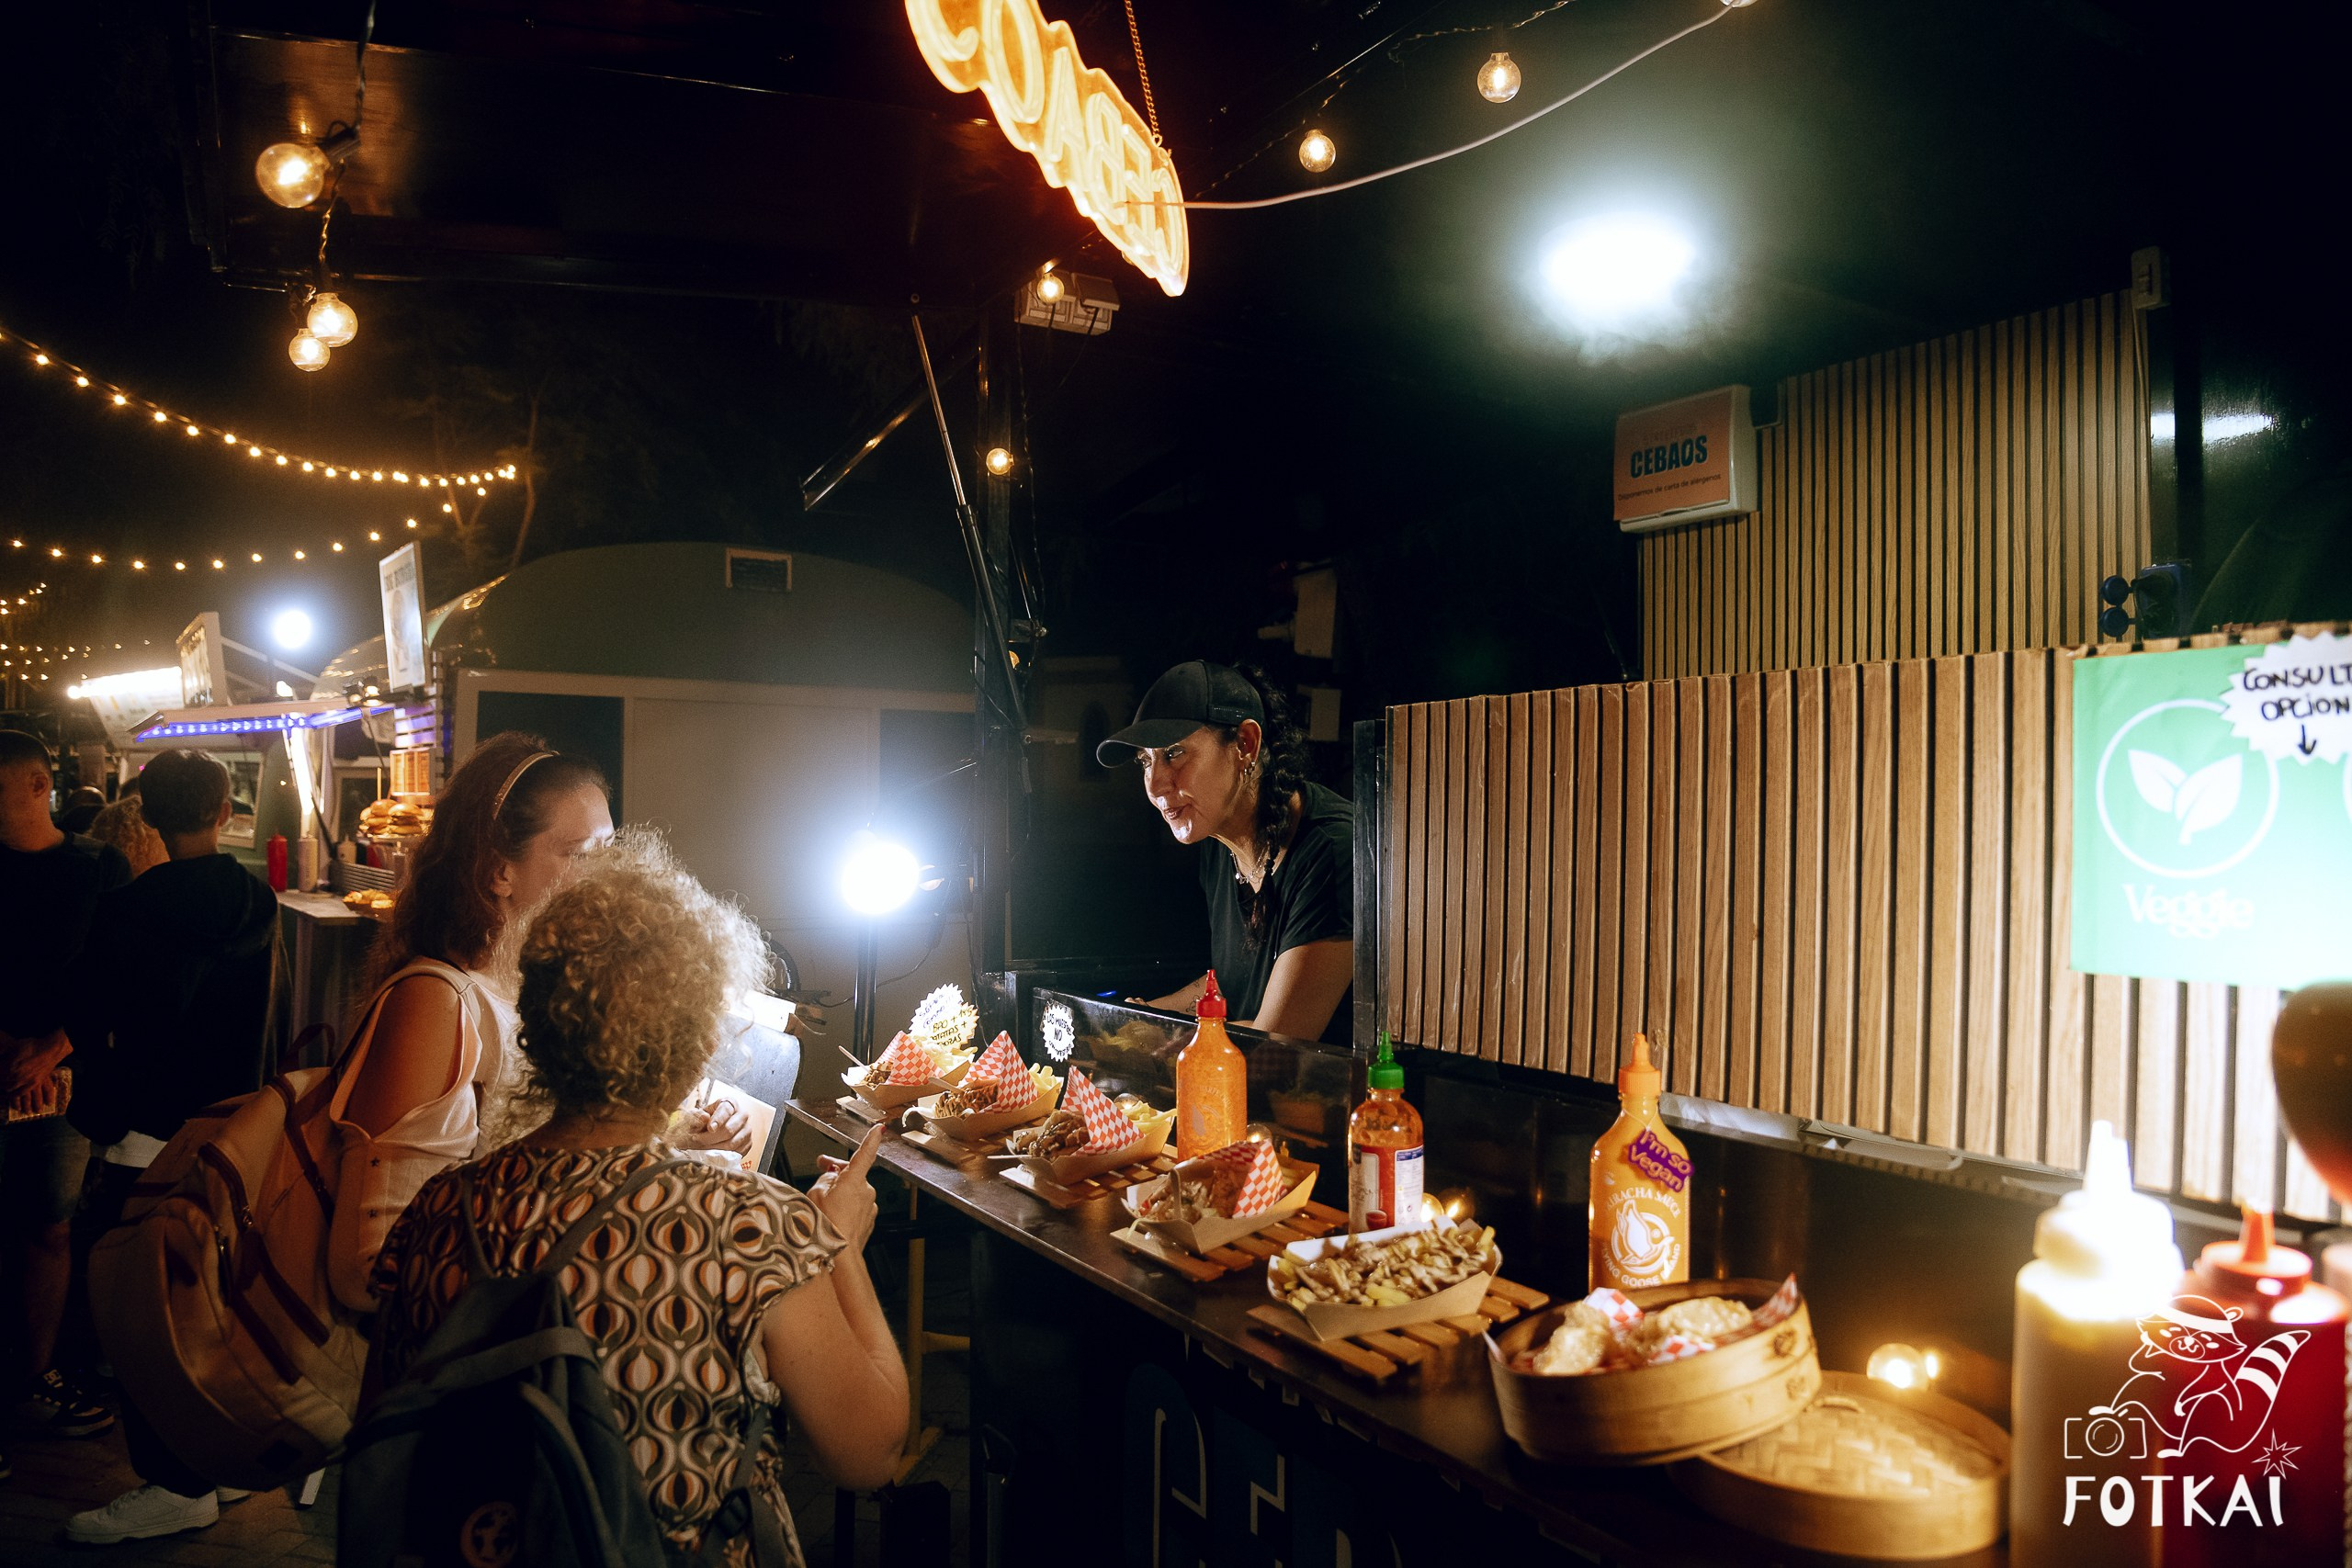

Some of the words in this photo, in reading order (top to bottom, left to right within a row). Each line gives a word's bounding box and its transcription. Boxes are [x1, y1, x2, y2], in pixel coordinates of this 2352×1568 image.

[1630, 434, 1709, 479] CEBAOS
[1655, 484, 1663, 493] de
[1664, 481, 1680, 491] carta
[1681, 479, 1690, 488] de
[2122, 883, 2255, 940] Veggie
[1054, 1027, 1063, 1042] NO
[1631, 1145, 1682, 1191] Vegan
[1668, 1154, 1691, 1175] so
[1621, 1274, 1662, 1288] GOOSE
